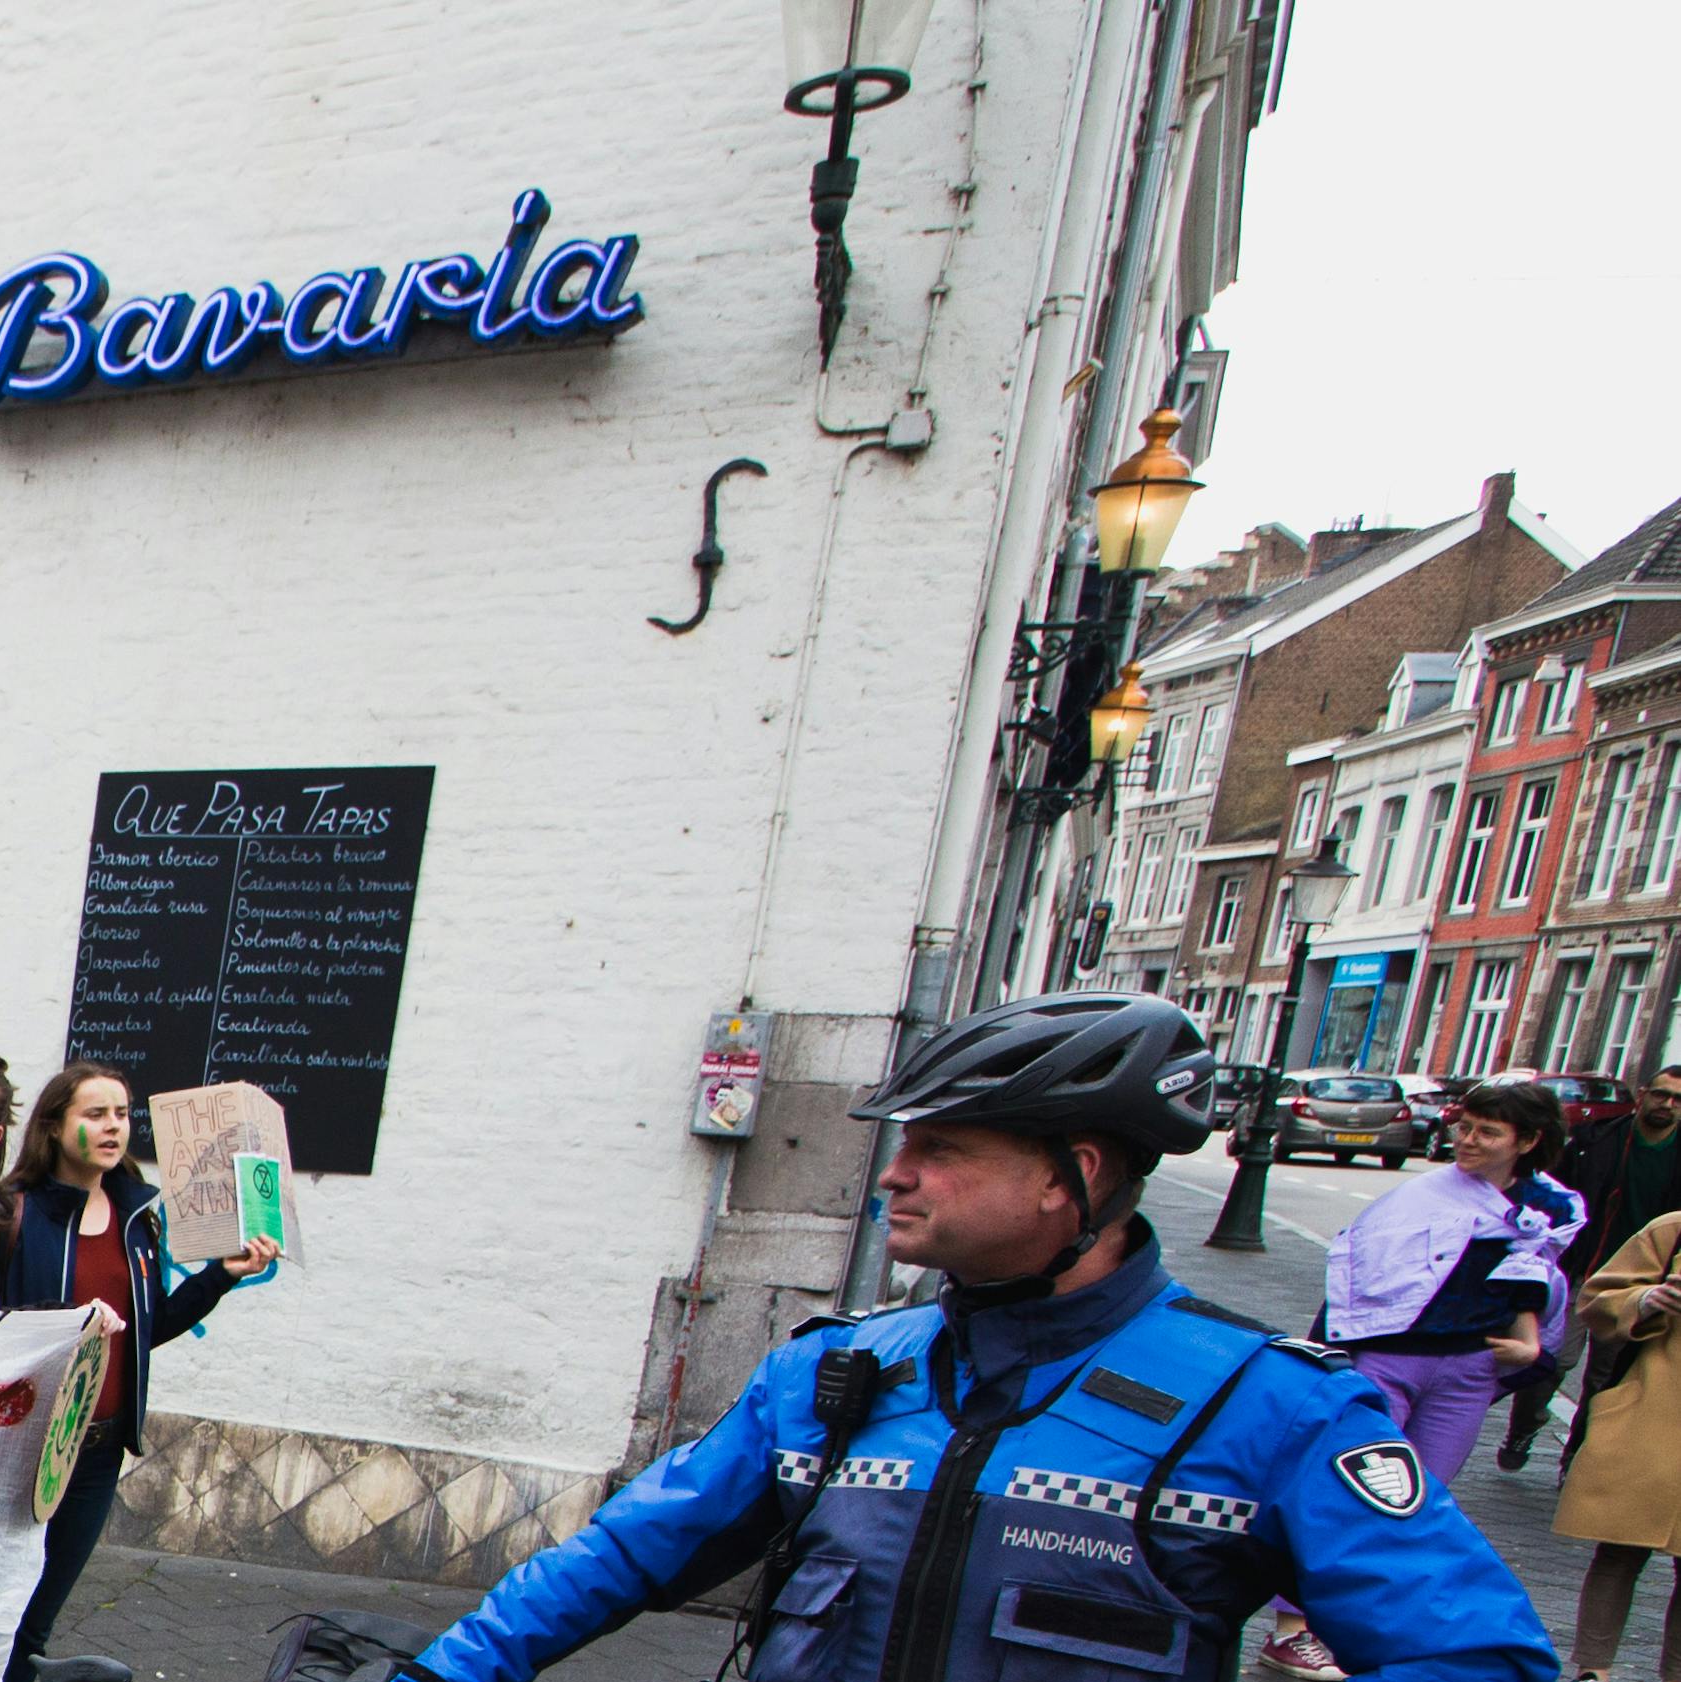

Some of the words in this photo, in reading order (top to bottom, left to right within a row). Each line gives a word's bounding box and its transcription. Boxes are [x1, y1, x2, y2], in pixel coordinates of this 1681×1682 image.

[192, 781, 285, 836] PASA
[302, 783, 392, 836] TAPAS
[1001, 1525, 1134, 1566] HANDHAVING
